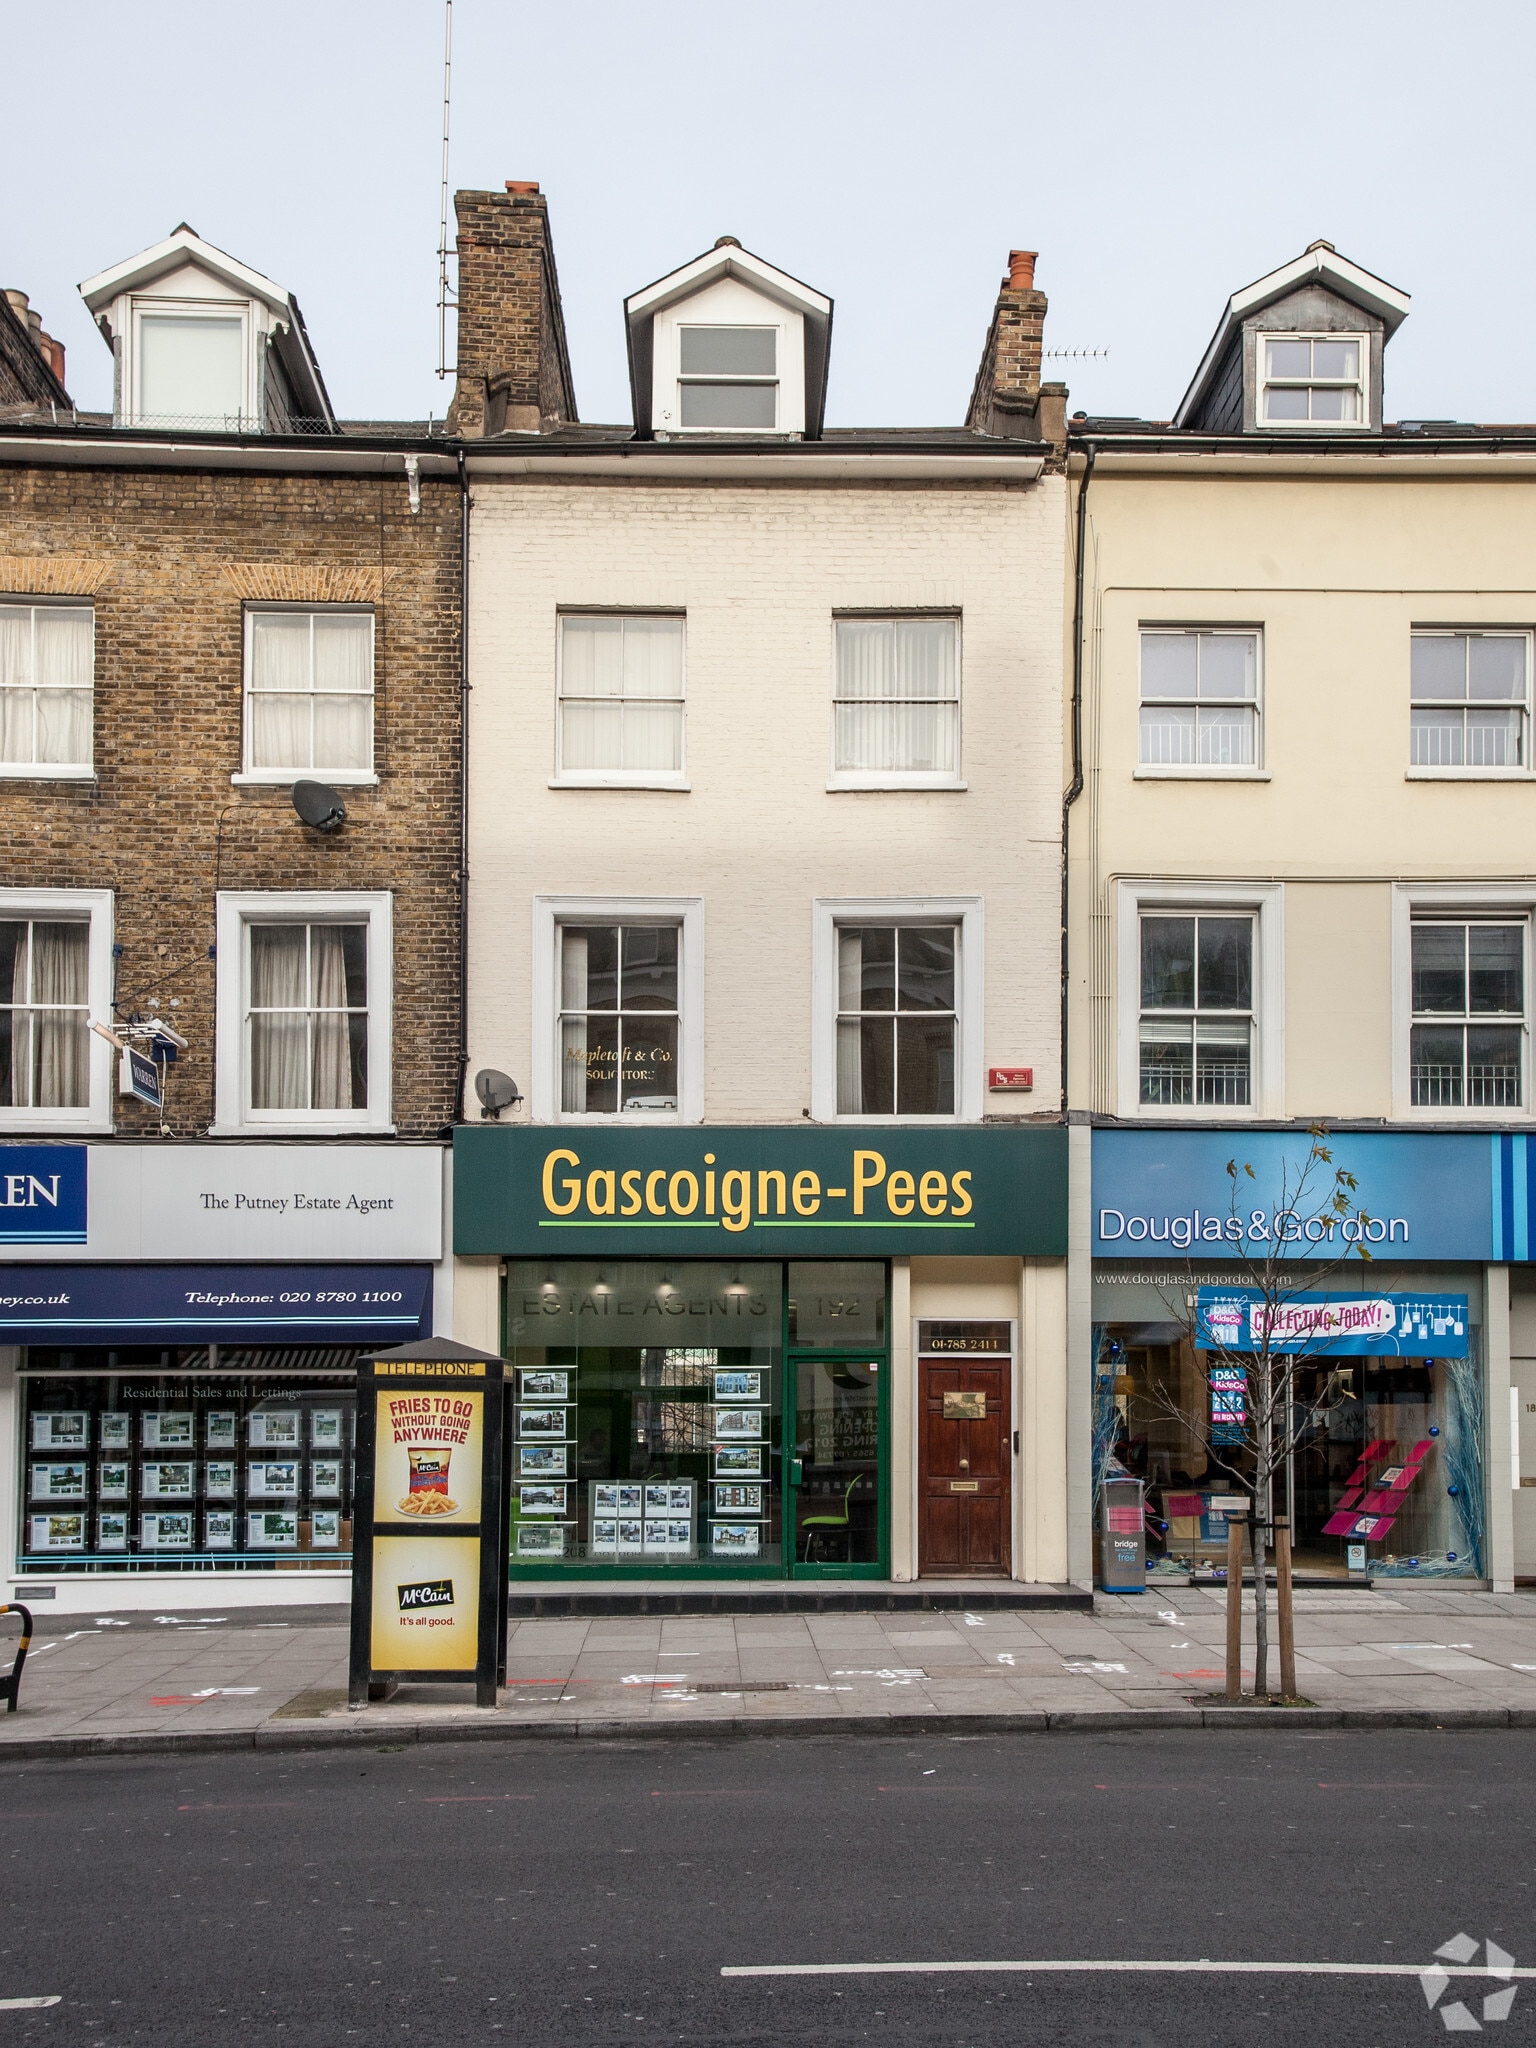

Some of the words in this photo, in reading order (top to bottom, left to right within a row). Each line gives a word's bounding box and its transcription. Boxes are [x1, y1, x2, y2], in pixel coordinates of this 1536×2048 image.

[635, 1051, 646, 1061] &
[132, 1063, 157, 1090] WARREN
[0, 1175, 61, 1207] EN
[541, 1147, 974, 1232] Gascoigne-Pees
[200, 1193, 229, 1209] The
[234, 1193, 289, 1214] Putney
[293, 1193, 341, 1209] Estate
[345, 1193, 394, 1214] Agent
[1098, 1208, 1410, 1248] Douglas&Gordon
[185, 1291, 274, 1306] Telephone:
[279, 1292, 311, 1303] 020
[315, 1292, 356, 1302] 8780
[361, 1291, 402, 1302] 1100
[522, 1293, 636, 1316] ESTATE
[642, 1293, 768, 1316] AGENTS
[1213, 1305, 1236, 1314] D&G
[1213, 1314, 1241, 1324] KidsCo
[1338, 1305, 1382, 1330] TODAY!
[384, 1362, 476, 1375] TELEPHONE
[1215, 1370, 1240, 1380] D&G
[1215, 1381, 1245, 1390] KidsCo
[123, 1386, 188, 1398] Residential
[192, 1386, 222, 1398] Sales
[226, 1386, 248, 1398] and
[252, 1386, 302, 1401] Lettings
[389, 1397, 430, 1417] FRIES
[434, 1398, 451, 1413] TO
[453, 1400, 473, 1418] GO
[391, 1415, 437, 1428] WITHOUT
[440, 1415, 471, 1430] GOING
[394, 1427, 468, 1445] ANYWHERE
[1114, 1540, 1138, 1549] bridge
[1117, 1552, 1136, 1562] free
[400, 1587, 453, 1607] McCain
[400, 1616, 414, 1626] It's
[416, 1616, 427, 1626] all
[429, 1616, 455, 1627] good.
